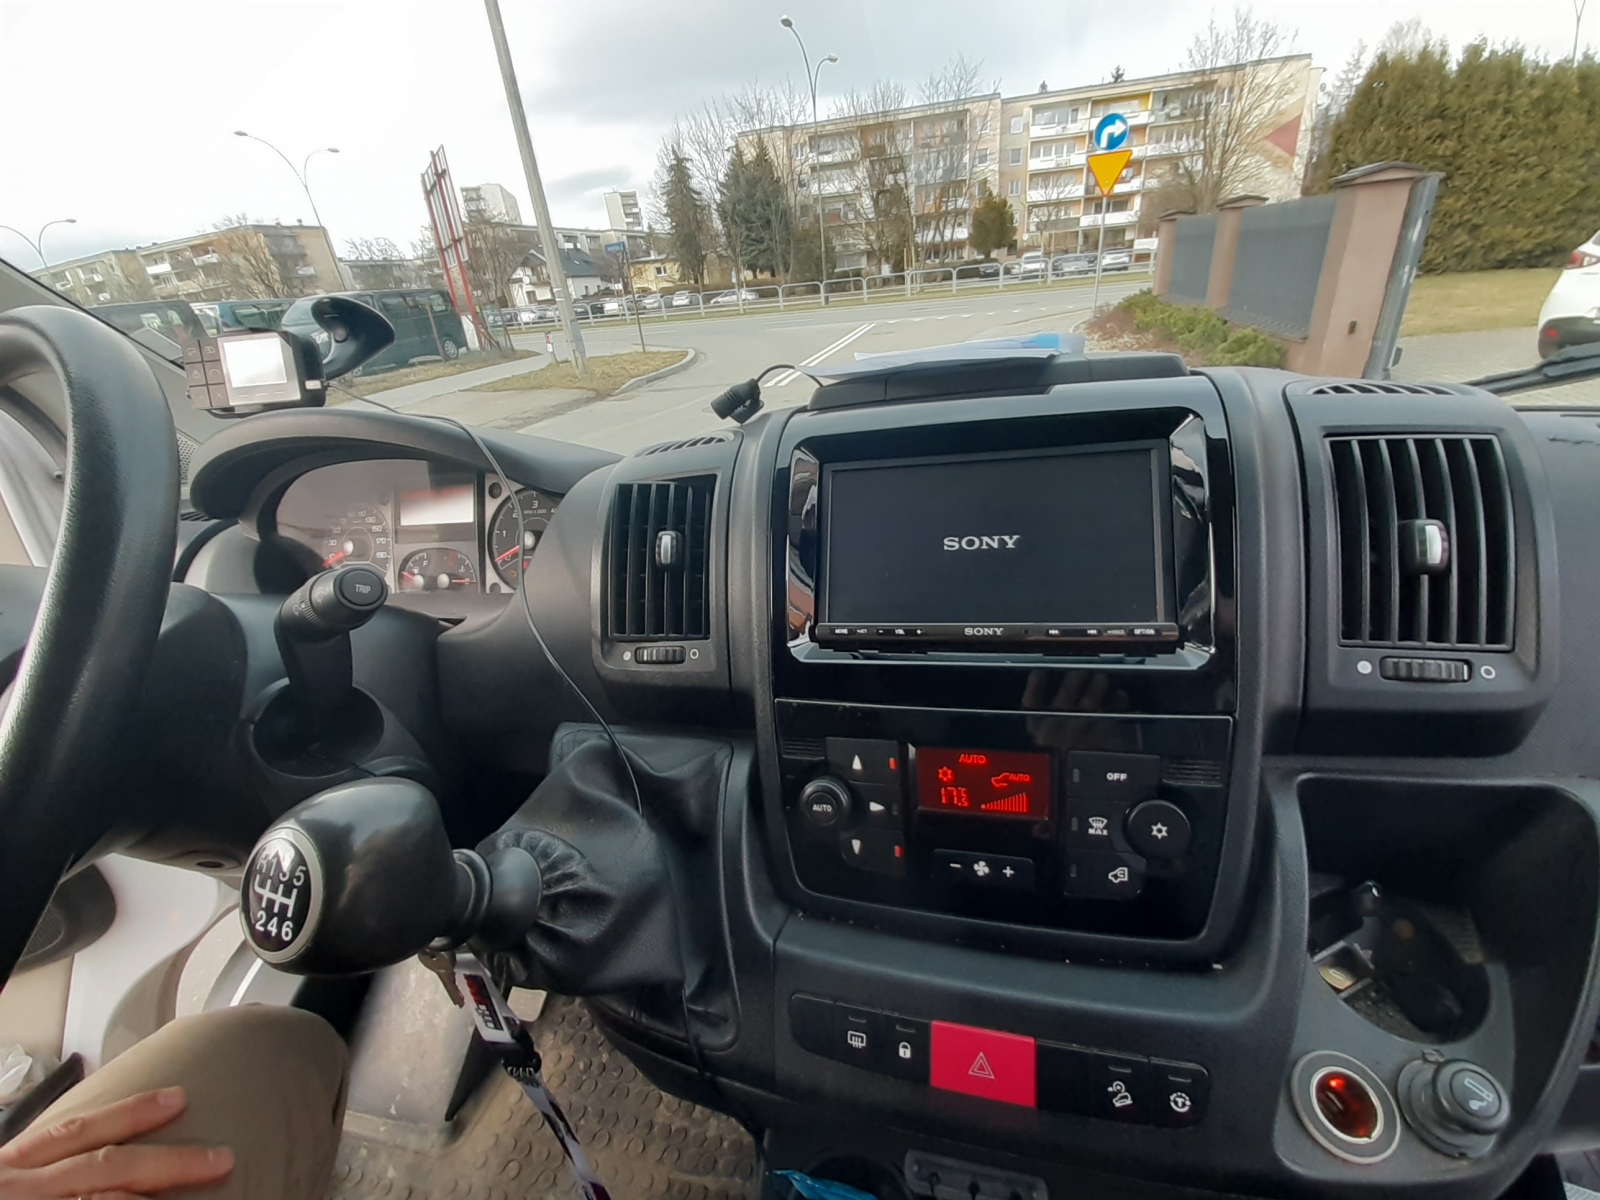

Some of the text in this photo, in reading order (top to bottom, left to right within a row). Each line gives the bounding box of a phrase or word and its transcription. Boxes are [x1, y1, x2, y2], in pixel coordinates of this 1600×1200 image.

[532, 500, 539, 509] 3
[502, 530, 507, 538] 1
[943, 535, 1021, 551] SONY
[355, 583, 371, 594] TRIP
[964, 627, 1004, 636] SONY
[1133, 628, 1155, 636] OPTION
[959, 753, 986, 764] AUTO
[1009, 773, 1030, 782] AUTO
[1106, 772, 1127, 781] OFF
[812, 803, 833, 812] AUTO
[1088, 828, 1108, 836] MAX
